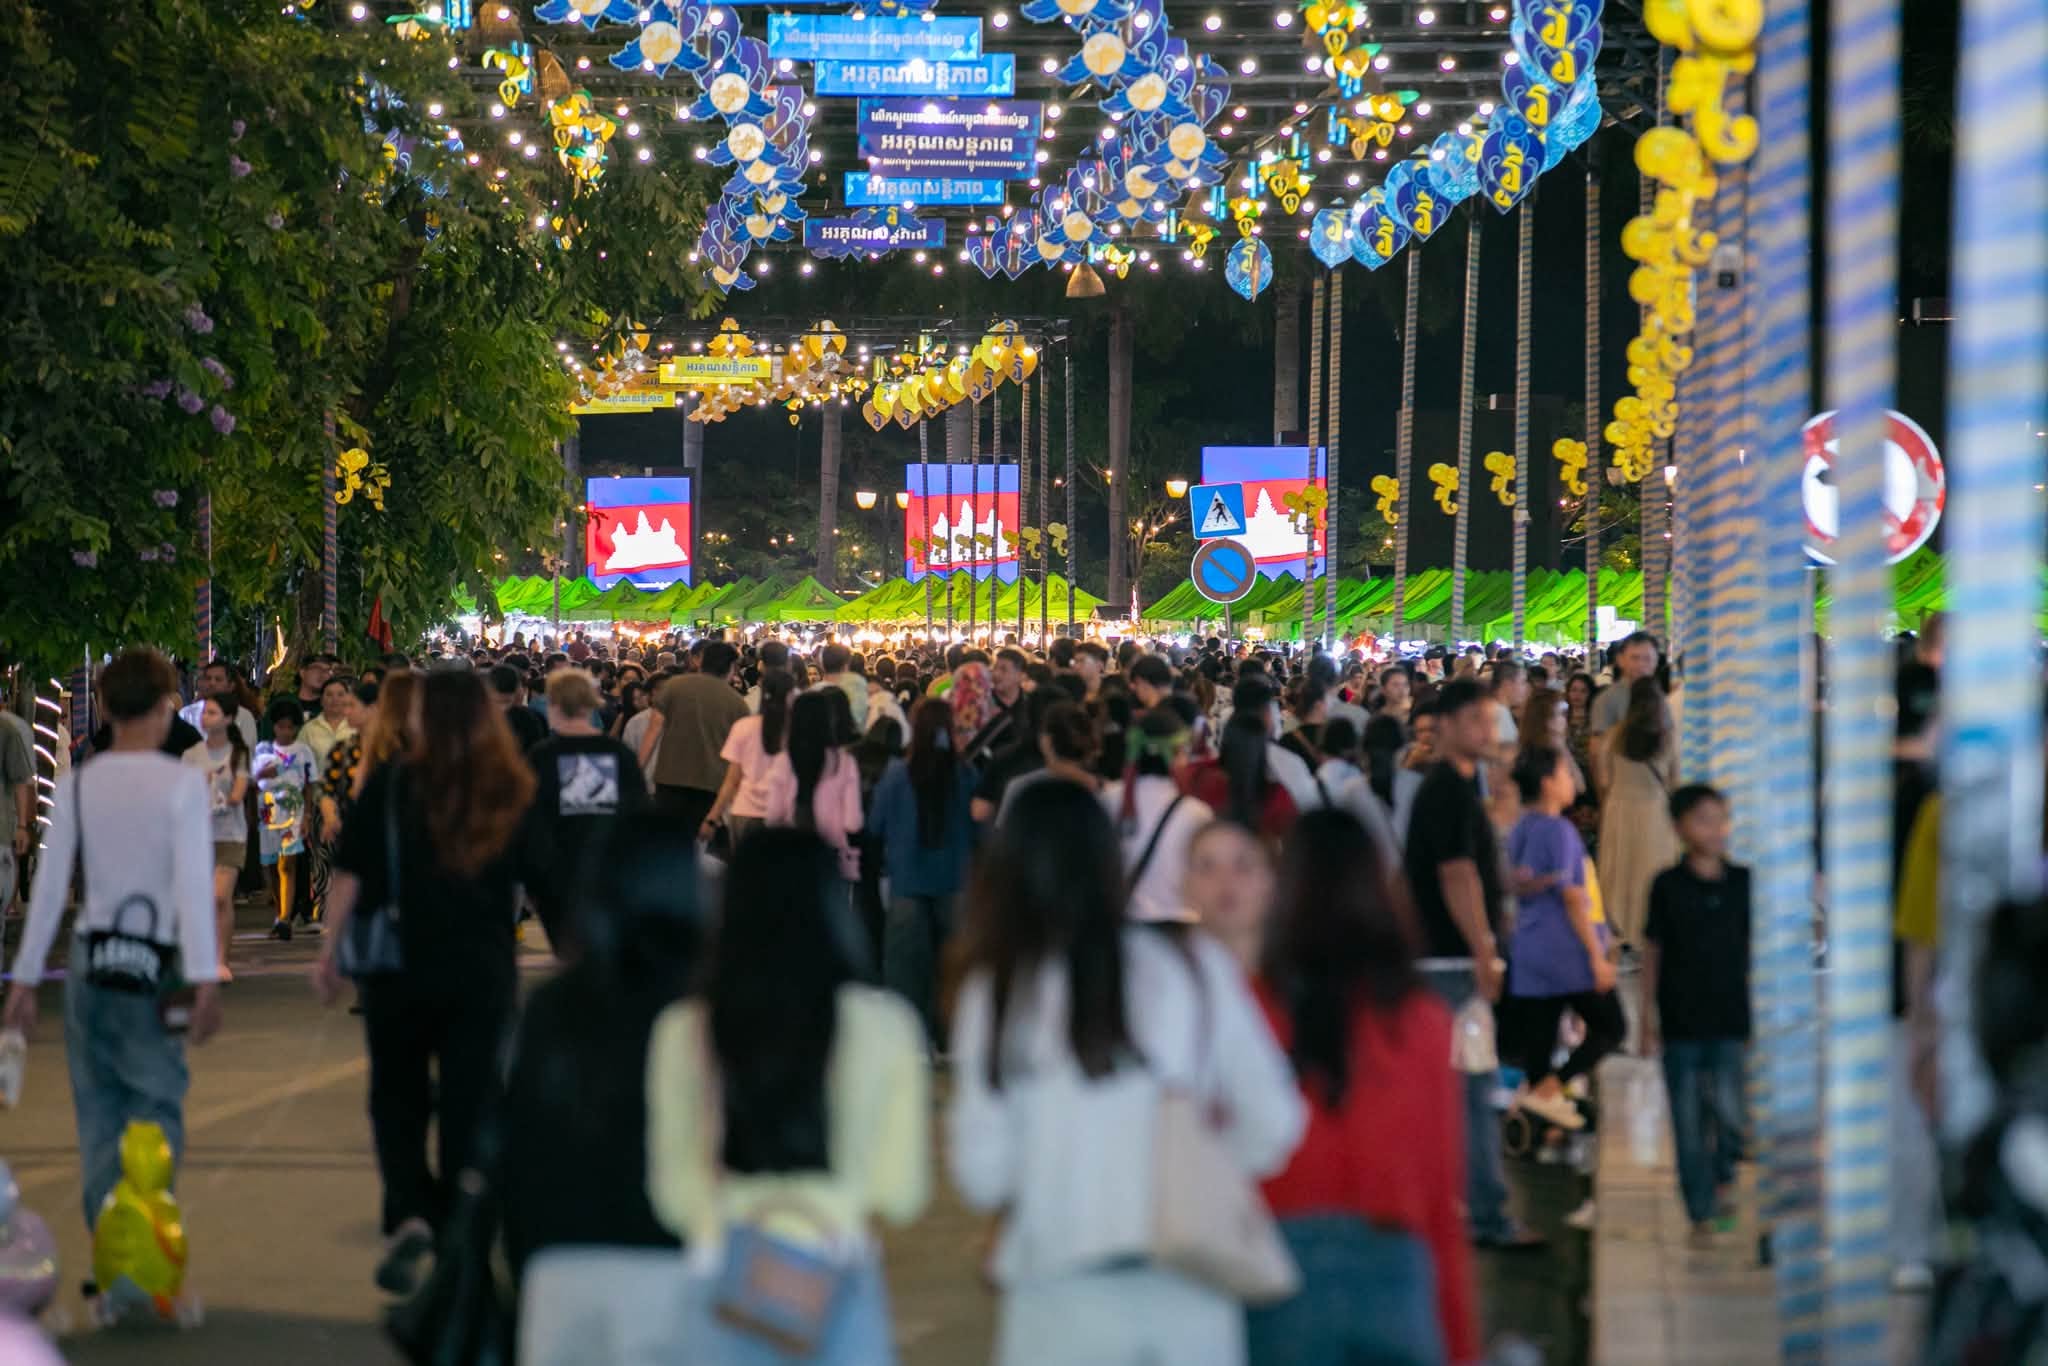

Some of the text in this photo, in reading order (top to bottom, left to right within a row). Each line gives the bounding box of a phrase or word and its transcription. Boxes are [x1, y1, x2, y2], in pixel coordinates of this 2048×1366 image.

[881, 134, 1013, 156] អរគុណសន្តភាព
